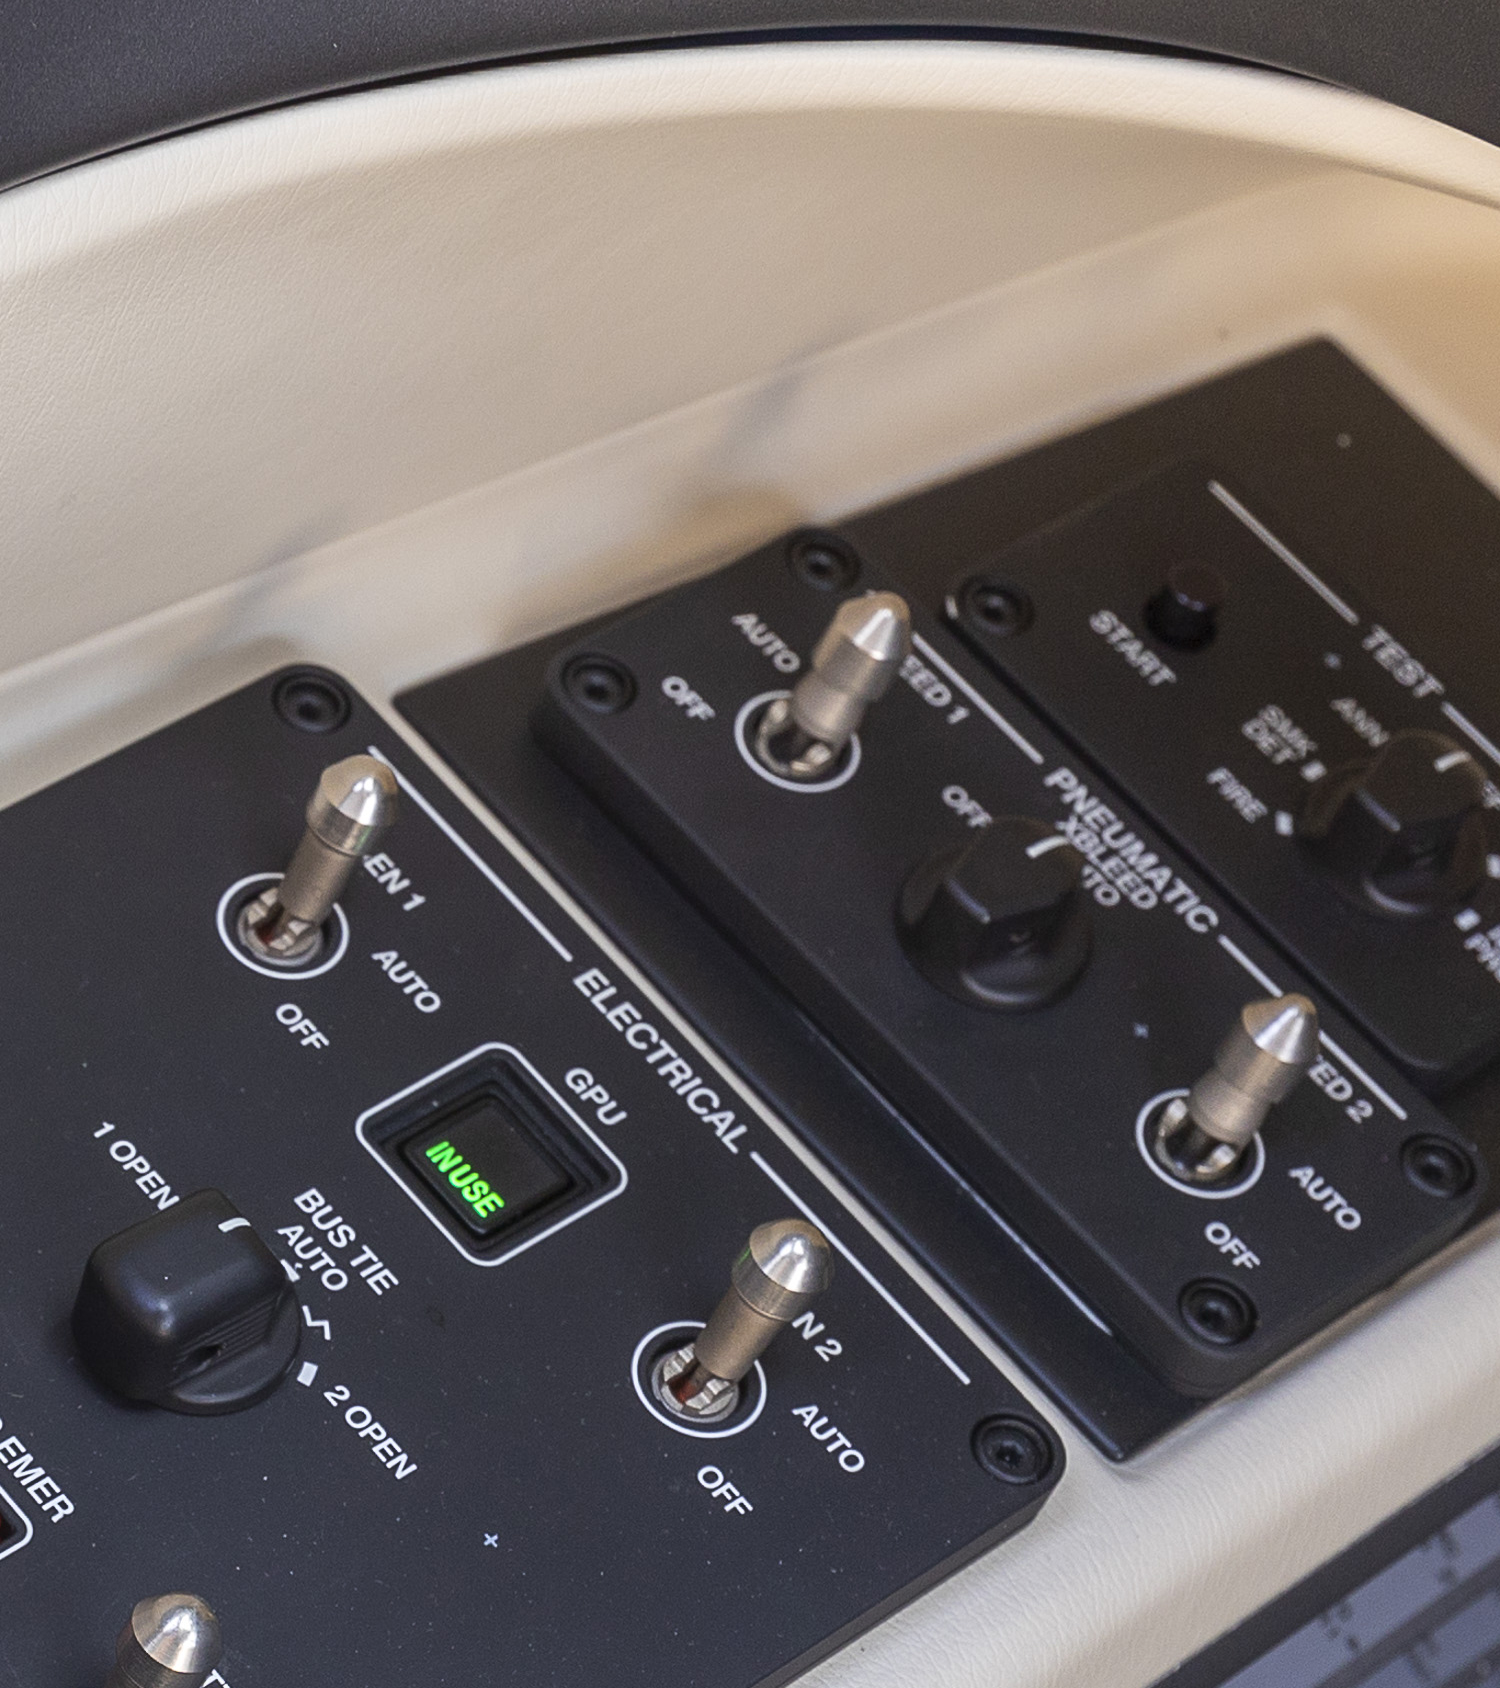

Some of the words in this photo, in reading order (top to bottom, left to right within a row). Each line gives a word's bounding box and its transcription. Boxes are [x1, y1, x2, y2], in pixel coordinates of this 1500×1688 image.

[731, 612, 801, 673] AUTO
[1090, 610, 1176, 685] START
[1363, 626, 1444, 697] TEST
[662, 676, 715, 720] OFF
[947, 704, 970, 725] 1
[941, 784, 993, 828] OFF
[1209, 768, 1267, 821] FIRE
[1045, 768, 1218, 932] PNEUMATIC
[363, 852, 411, 895] EN
[402, 893, 427, 911] 1
[372, 951, 441, 1013] AUTO
[276, 1004, 329, 1049] OFF
[573, 968, 743, 1154] ELECTRICAL
[564, 1067, 627, 1128] GPU
[1346, 1099, 1373, 1124] 2
[93, 1121, 115, 1138] 1
[109, 1138, 180, 1210] OPEN
[1289, 1166, 1361, 1230] AUTO
[277, 1226, 348, 1291] AUTO
[294, 1188, 355, 1248] BUS
[350, 1245, 399, 1295] TIE
[1205, 1222, 1260, 1268] OFF
[818, 1337, 843, 1361] 2
[323, 1385, 350, 1407] 2
[341, 1404, 418, 1481] OPEN
[792, 1405, 864, 1472] AUTO
[697, 1465, 753, 1514] OFF
